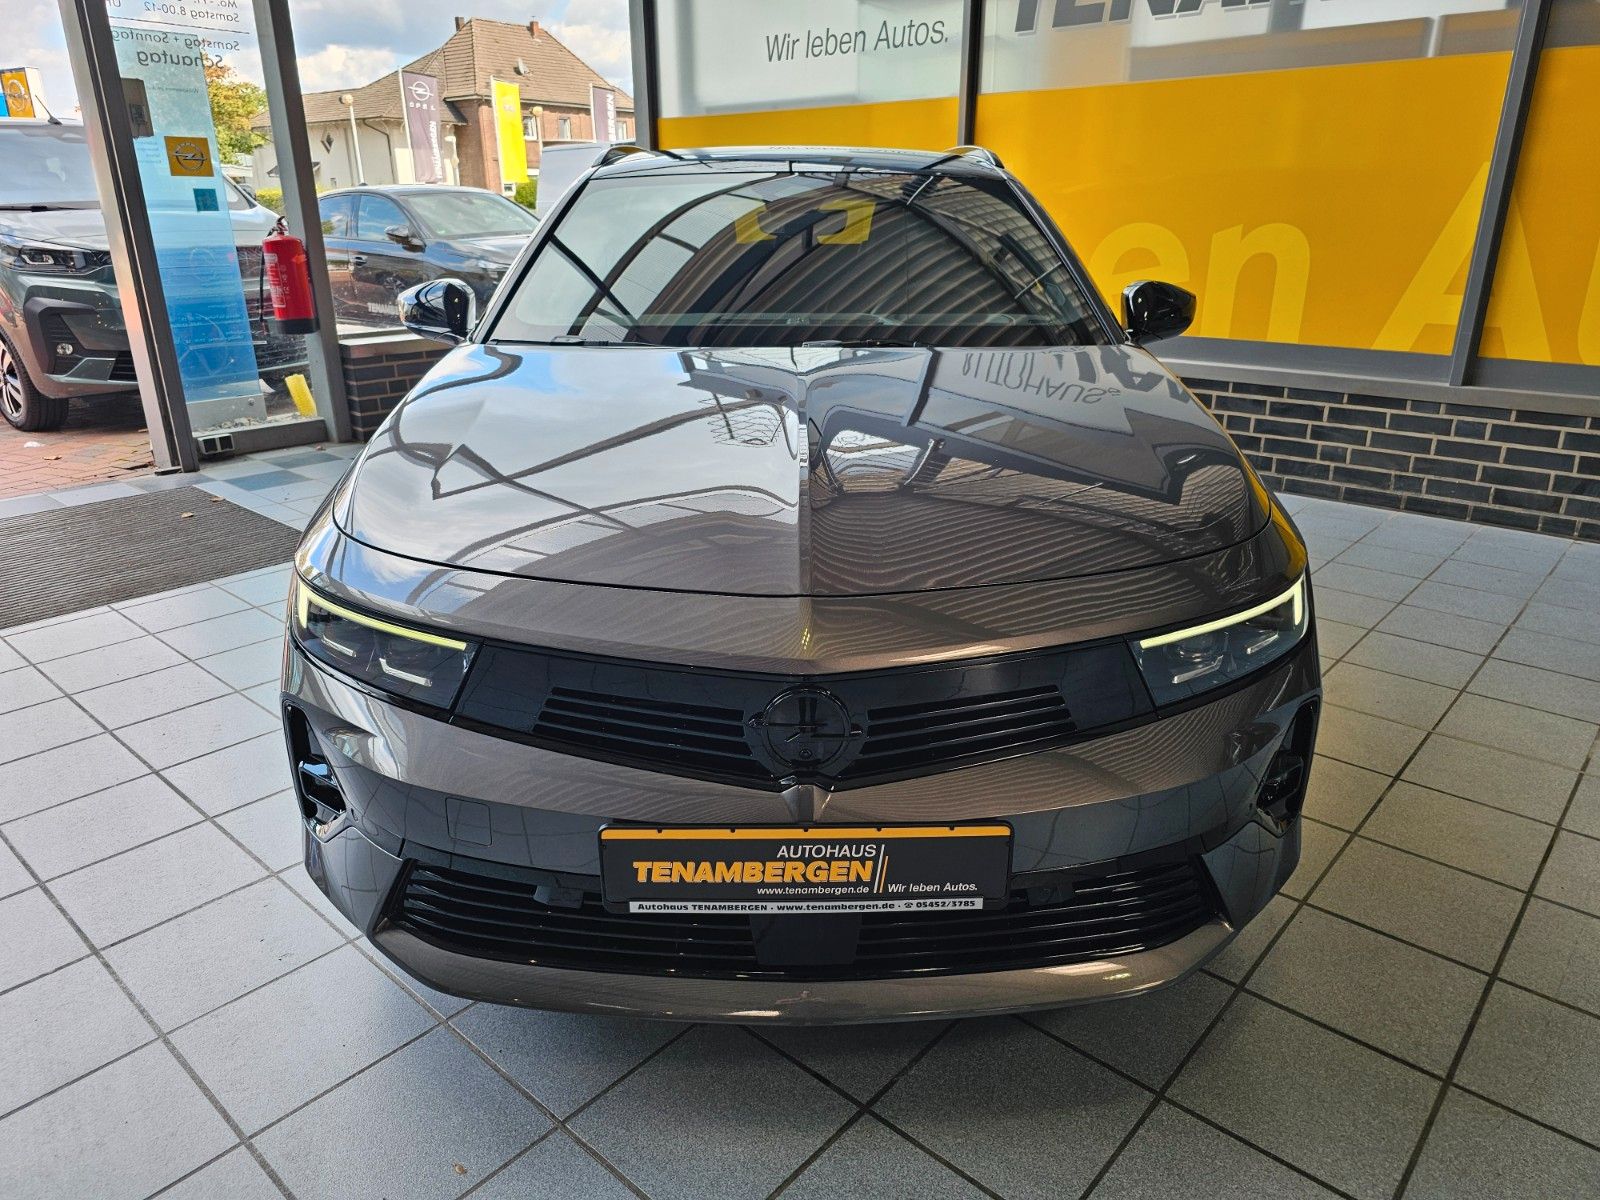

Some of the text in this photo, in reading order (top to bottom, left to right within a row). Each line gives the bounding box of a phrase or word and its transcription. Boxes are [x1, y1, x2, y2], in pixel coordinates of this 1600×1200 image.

[765, 19, 950, 63] Wir leben Autos.
[776, 844, 877, 859] AUTOHAUS
[632, 859, 874, 884] TENAMBERGEN
[756, 885, 870, 895] www.tenambergen.de
[887, 881, 979, 893] Wir leben Autos.
[637, 900, 976, 912] Autohaus TENAMBERGEN www.tenambergen.de 05452/3785
